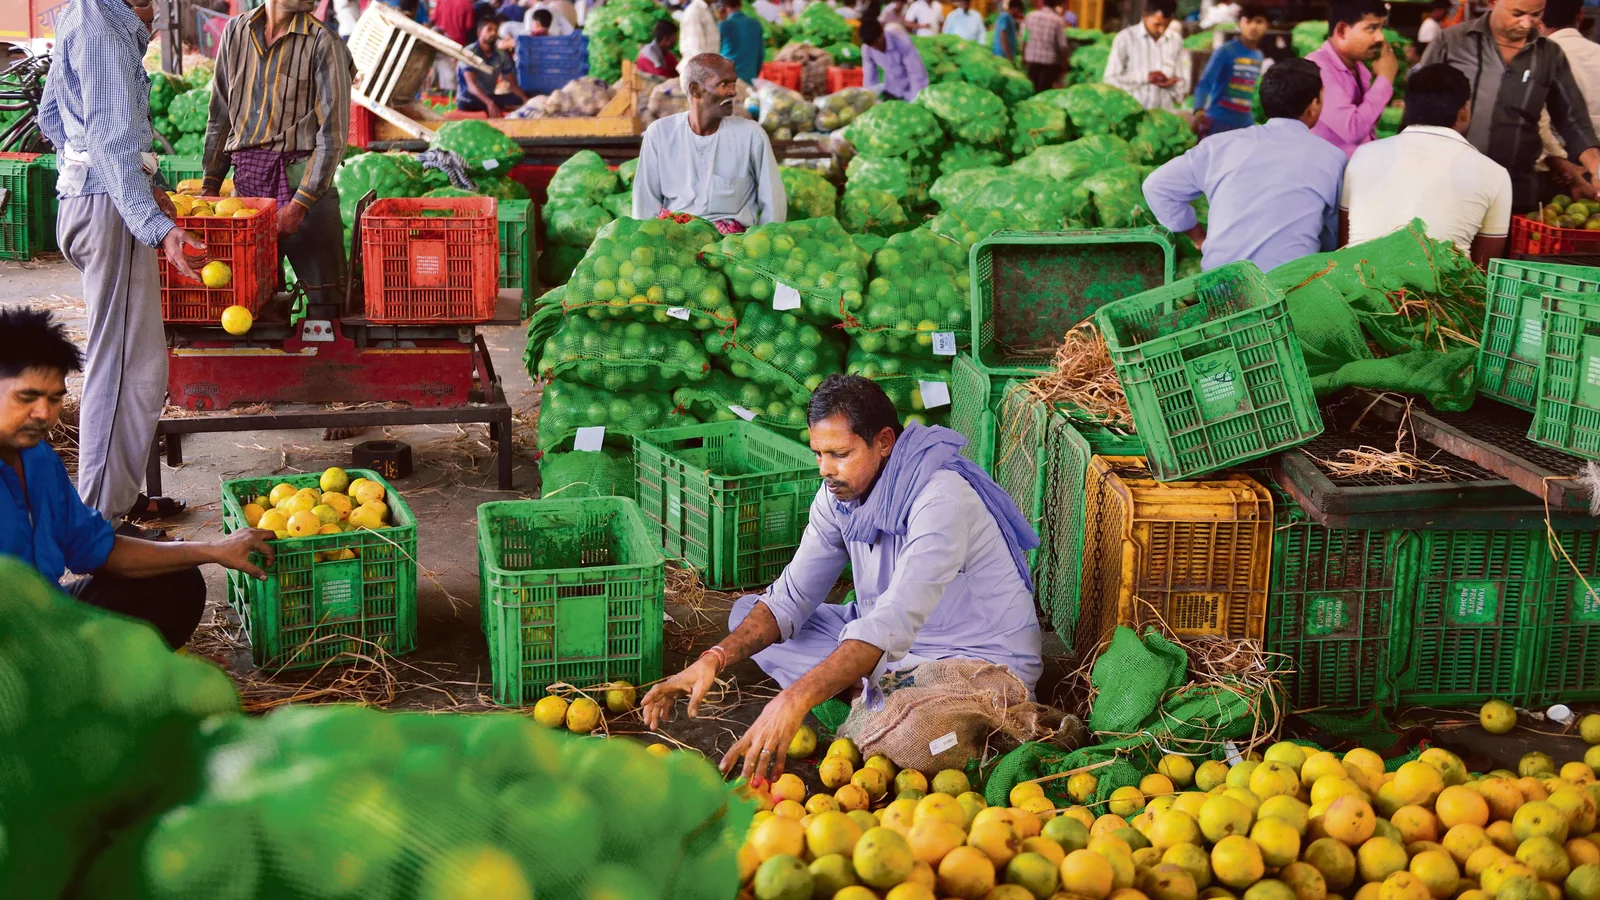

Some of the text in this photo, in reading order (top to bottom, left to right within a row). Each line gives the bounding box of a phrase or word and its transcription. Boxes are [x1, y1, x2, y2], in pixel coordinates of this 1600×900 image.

[1459, 587, 1469, 617] ABOHAR
[1468, 588, 1477, 613] FRUITS
[1476, 588, 1486, 615] YUVRAJ
[1325, 601, 1334, 627] FRUITS
